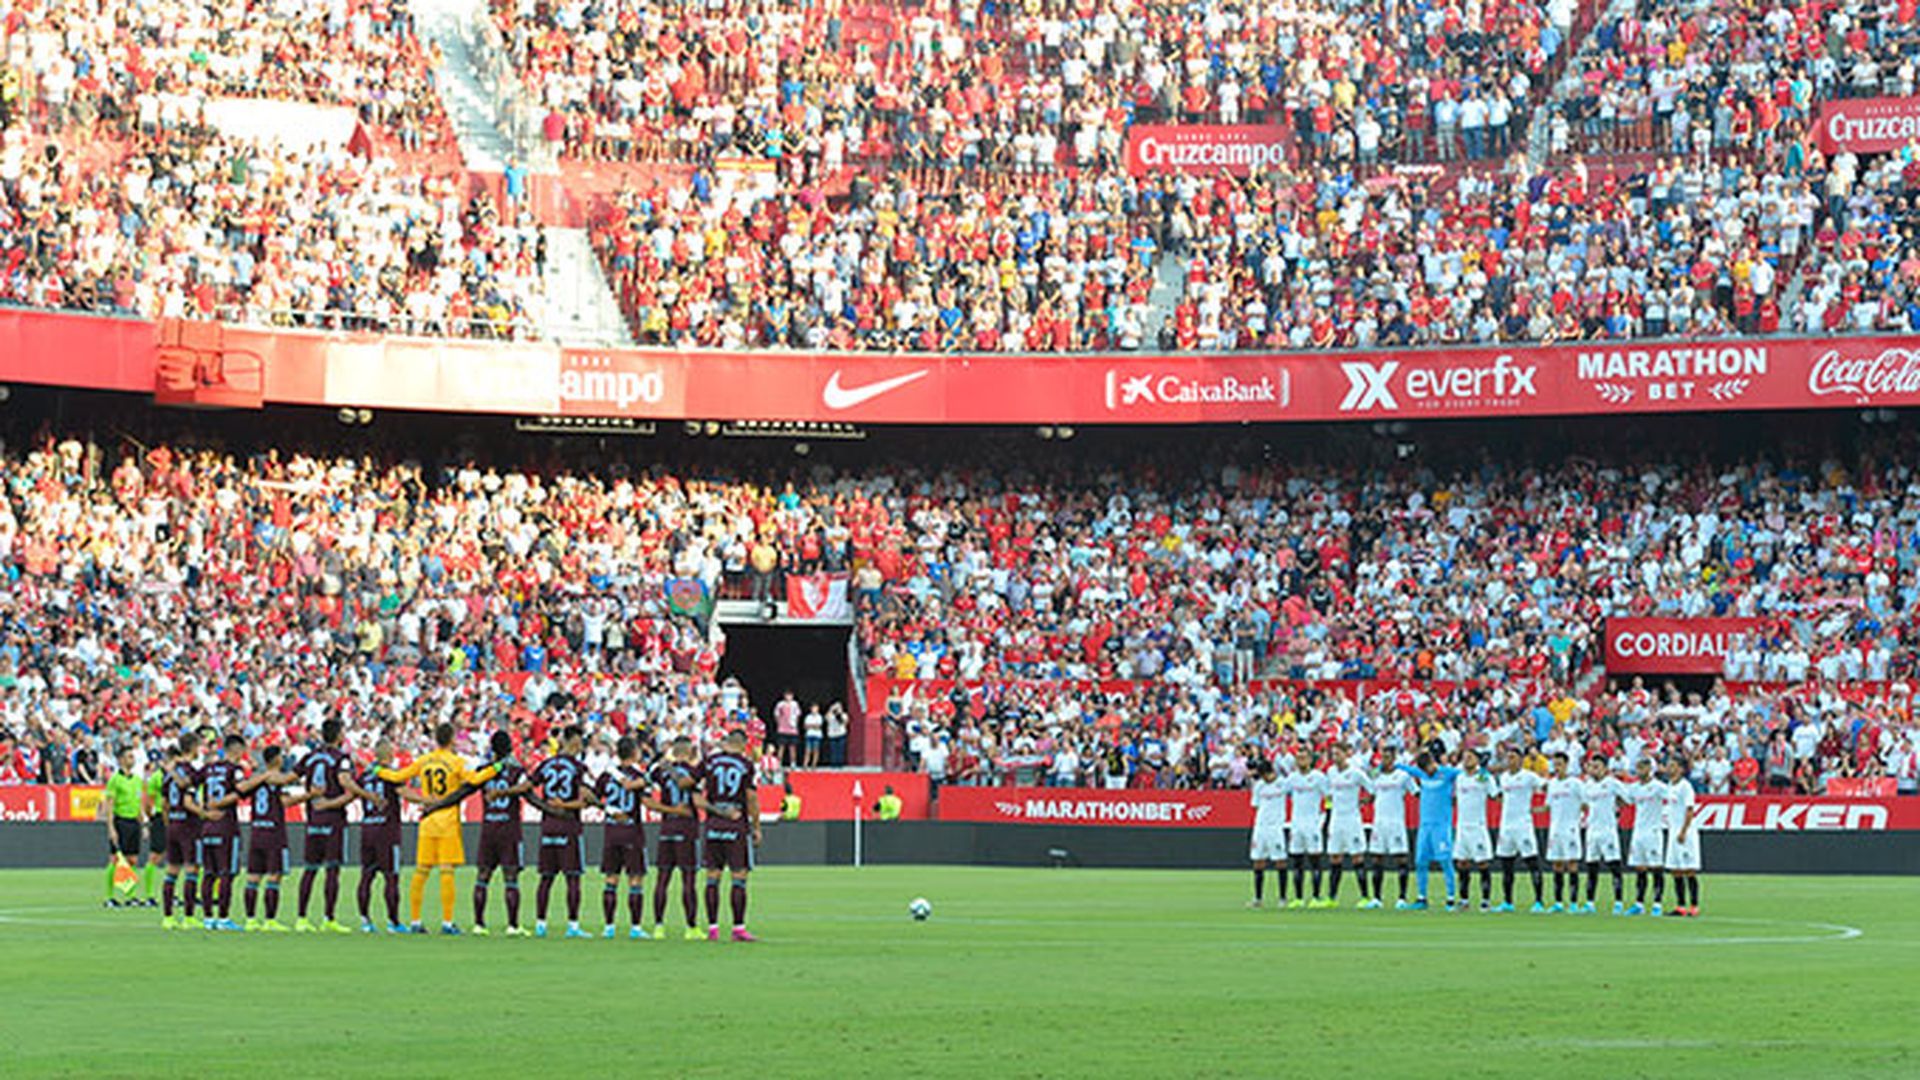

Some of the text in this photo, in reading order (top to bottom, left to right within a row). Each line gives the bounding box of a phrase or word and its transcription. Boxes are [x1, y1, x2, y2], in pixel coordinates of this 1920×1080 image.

[1829, 112, 1920, 142] Cruzca
[1139, 137, 1284, 166] Cruzcampo
[1406, 355, 1537, 398] everfx
[1577, 347, 1767, 379] MARATHON
[1156, 375, 1275, 402] CaixaBank
[1648, 381, 1695, 399] BET
[424, 767, 447, 796] 13
[543, 767, 573, 798] 23
[714, 764, 740, 797] 19
[0, 800, 41, 821] ank
[256, 785, 269, 816] 8
[606, 781, 634, 812] 20
[1025, 800, 1185, 821] MARATHONBET
[1693, 803, 1888, 831] ALKEN
